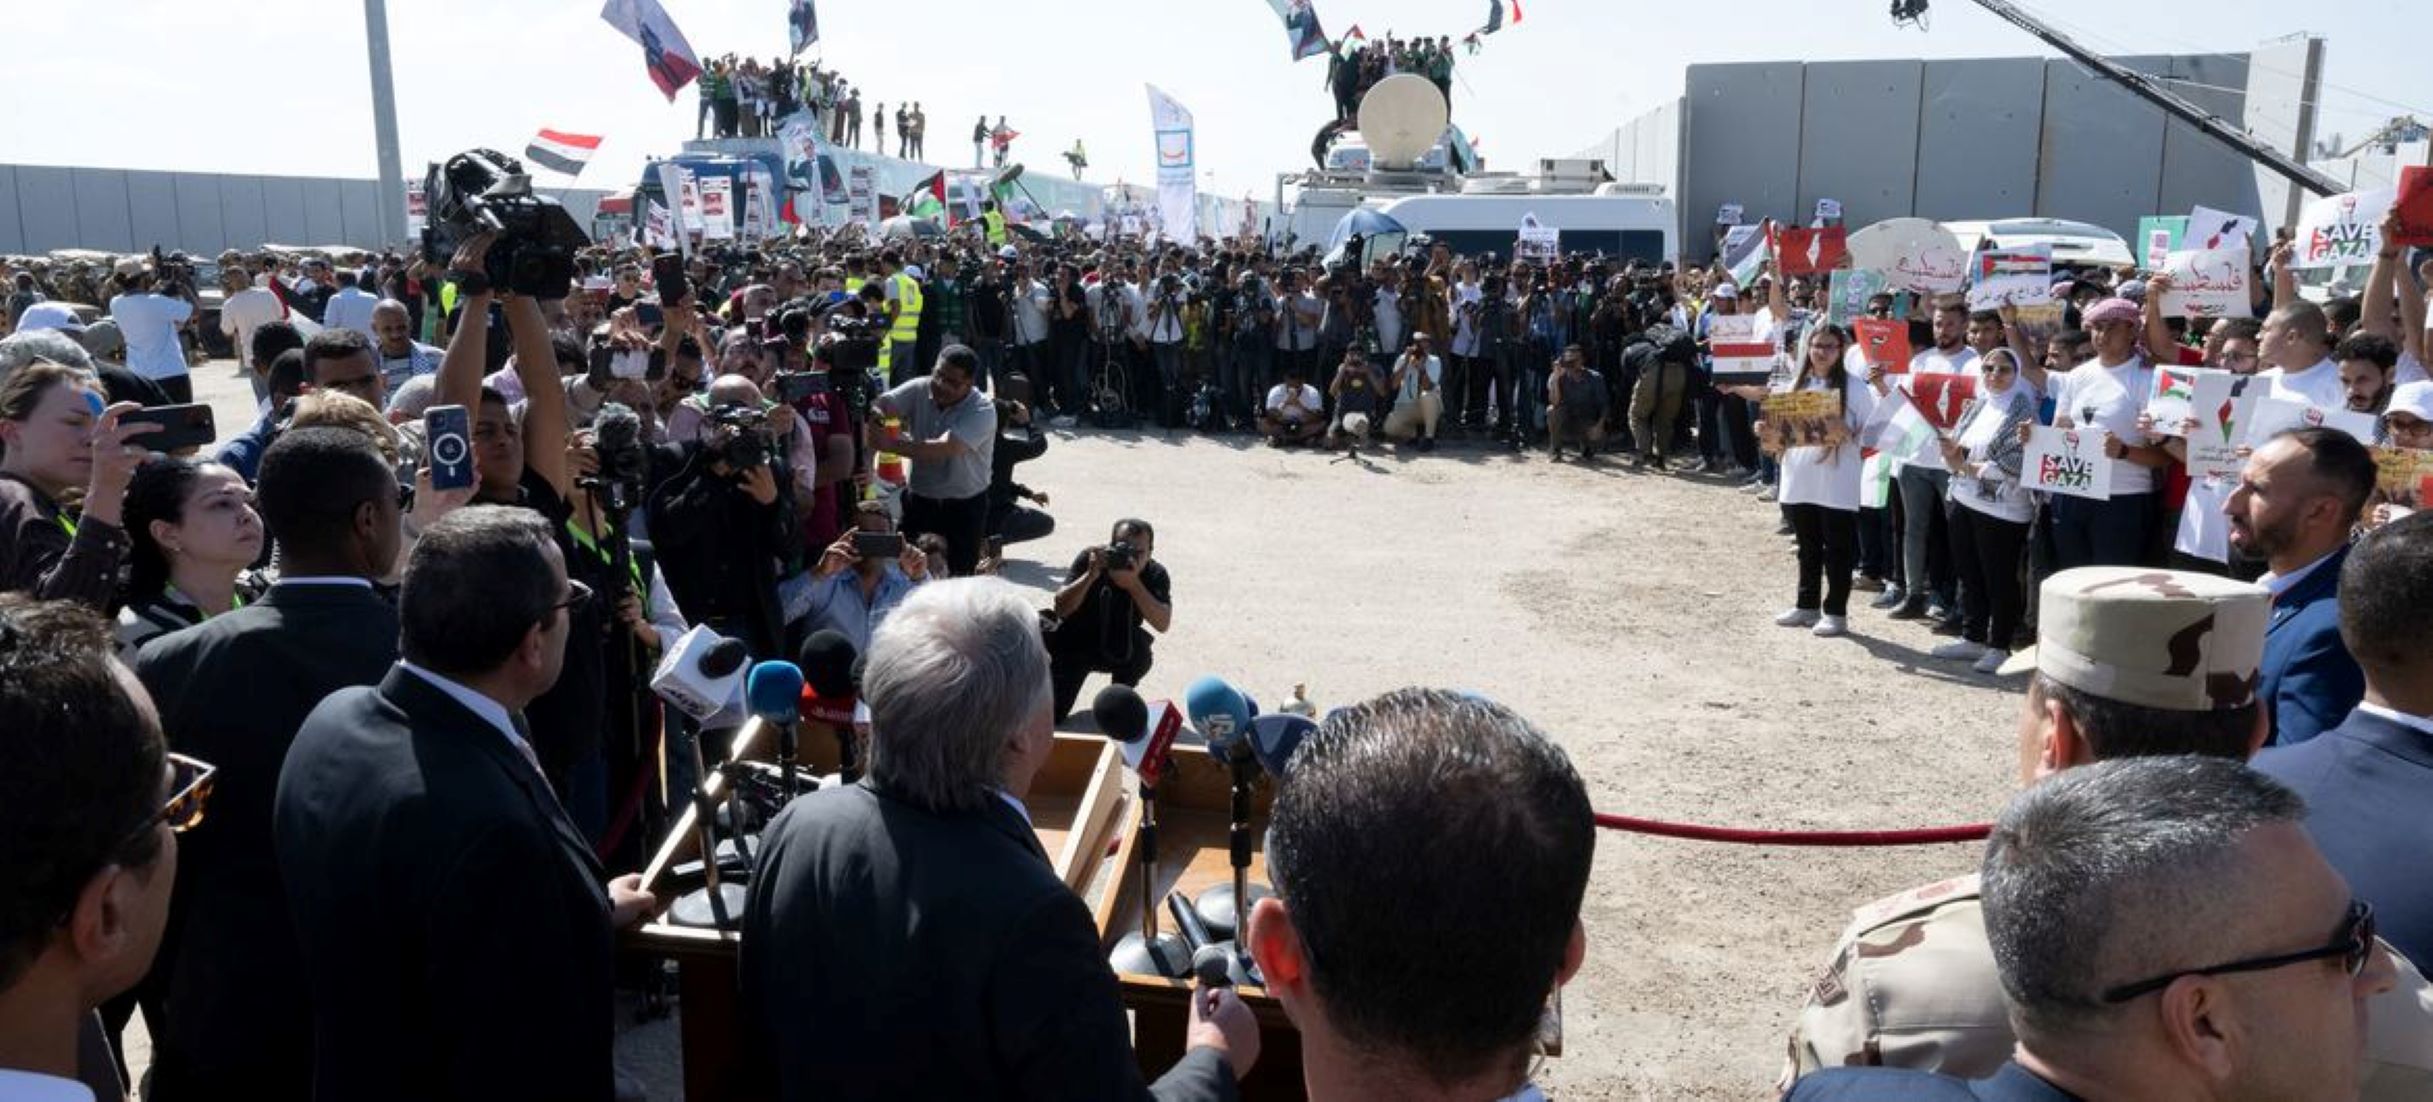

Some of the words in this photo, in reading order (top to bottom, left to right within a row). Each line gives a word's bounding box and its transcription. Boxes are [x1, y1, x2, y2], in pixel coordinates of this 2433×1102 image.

[2316, 222, 2374, 241] SAVE
[2312, 240, 2371, 261] GAZA
[2044, 455, 2093, 474] SAVE
[2042, 470, 2092, 490] GAZA
